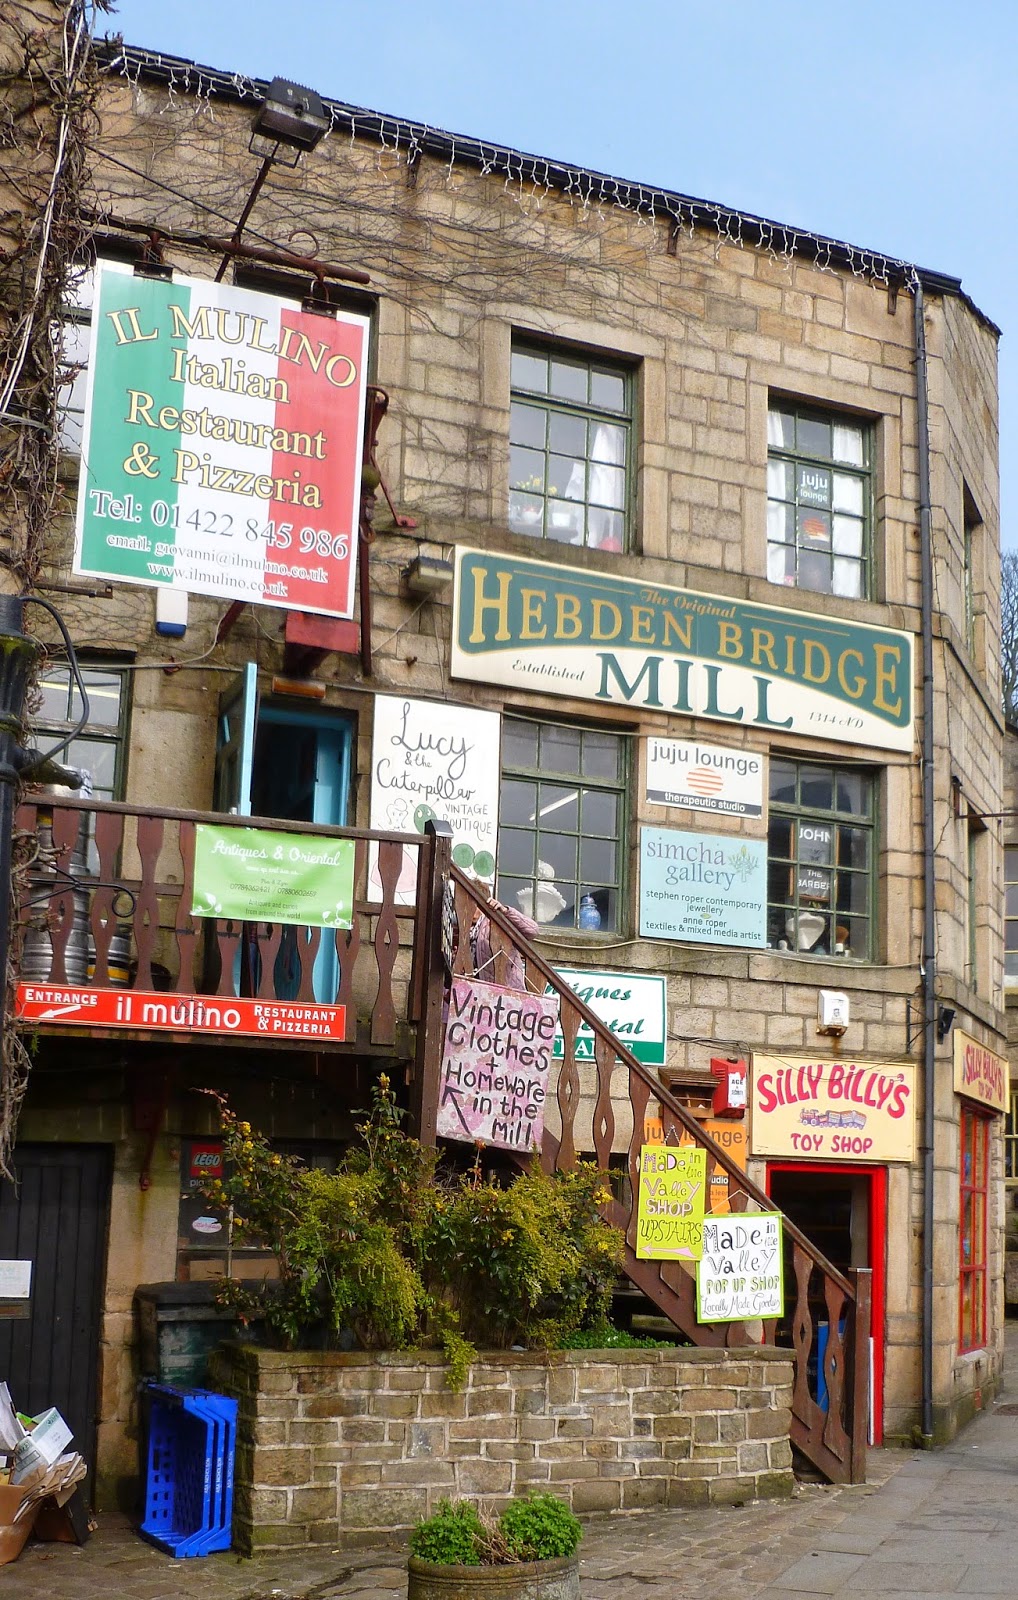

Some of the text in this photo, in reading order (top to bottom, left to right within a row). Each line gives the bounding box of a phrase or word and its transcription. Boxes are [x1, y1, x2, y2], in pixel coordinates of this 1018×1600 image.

[106, 304, 356, 387] IL MULINO
[171, 348, 290, 404] Italian
[125, 390, 328, 460] Restaurant
[123, 441, 322, 509] & Pizzeria
[801, 471, 828, 490] juju
[800, 488, 828, 503] lounge
[91, 491, 347, 559] Tel: 01422 845 986
[107, 534, 328, 583] email: giovanni@ilmulino.co.uk
[147, 562, 288, 597] www.ilmulino.co.uk
[639, 588, 737, 619] The Original
[469, 567, 902, 718] HEBDEN BRIDGE
[512, 659, 585, 682] Established
[595, 652, 794, 729] MILL
[391, 702, 475, 780] Lucy
[404, 751, 432, 768] & the
[651, 741, 759, 775] juju lounge
[376, 758, 477, 801] Caterpillar
[445, 803, 489, 817] VINTAGE
[664, 792, 746, 813] therapeutic studio
[211, 839, 340, 866] Antiques & Oriental
[647, 837, 726, 866] simcha
[665, 862, 736, 891] gallery
[807, 869, 823, 878] THE
[646, 890, 761, 911] stephen roper contemporary
[687, 903, 723, 916] jewellery
[646, 921, 762, 940] textiles & mixed media artist
[683, 917, 727, 929] anne roper
[25, 988, 98, 1005] ENTRANCE
[116, 996, 241, 1029] il mulino
[254, 1005, 337, 1022] RESTAURANT
[257, 1016, 332, 1035] & PIZZERIA
[452, 988, 555, 1042] Vintage
[449, 1023, 549, 1072] Clothes
[446, 1060, 545, 1104] Homeware
[473, 1092, 538, 1120] in the
[491, 1119, 532, 1147] Mill
[790, 1133, 873, 1154] TOY SHOP
[193, 1152, 220, 1167] LEGO
[690, 1152, 700, 1163] in
[646, 1198, 693, 1217] SHOP
[640, 1218, 702, 1245] UPSTAIRS
[766, 1221, 776, 1234] in
[706, 1275, 780, 1295] POP UP SHOP
